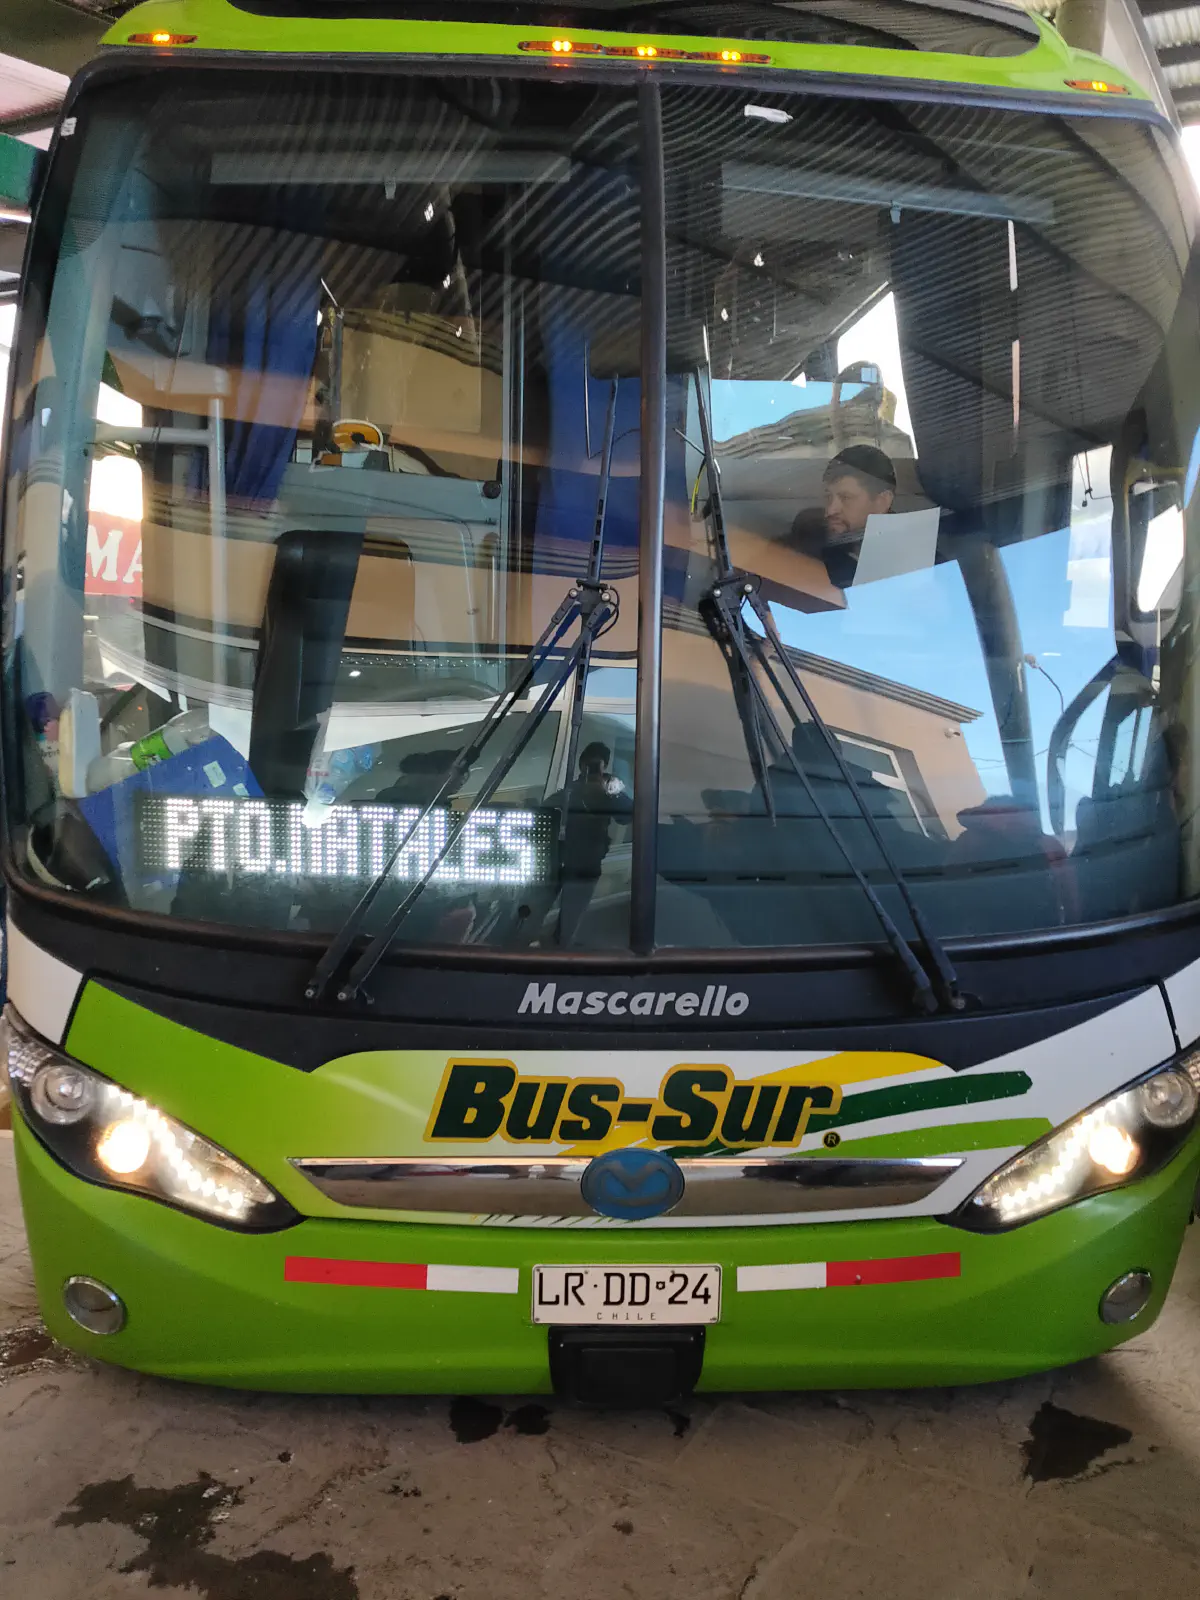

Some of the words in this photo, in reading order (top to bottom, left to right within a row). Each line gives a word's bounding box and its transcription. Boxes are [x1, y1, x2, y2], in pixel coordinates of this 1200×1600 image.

[517, 982, 750, 1017] Mascarello
[427, 1061, 838, 1146] Bus-Sur
[596, 1311, 657, 1321] CHILE
